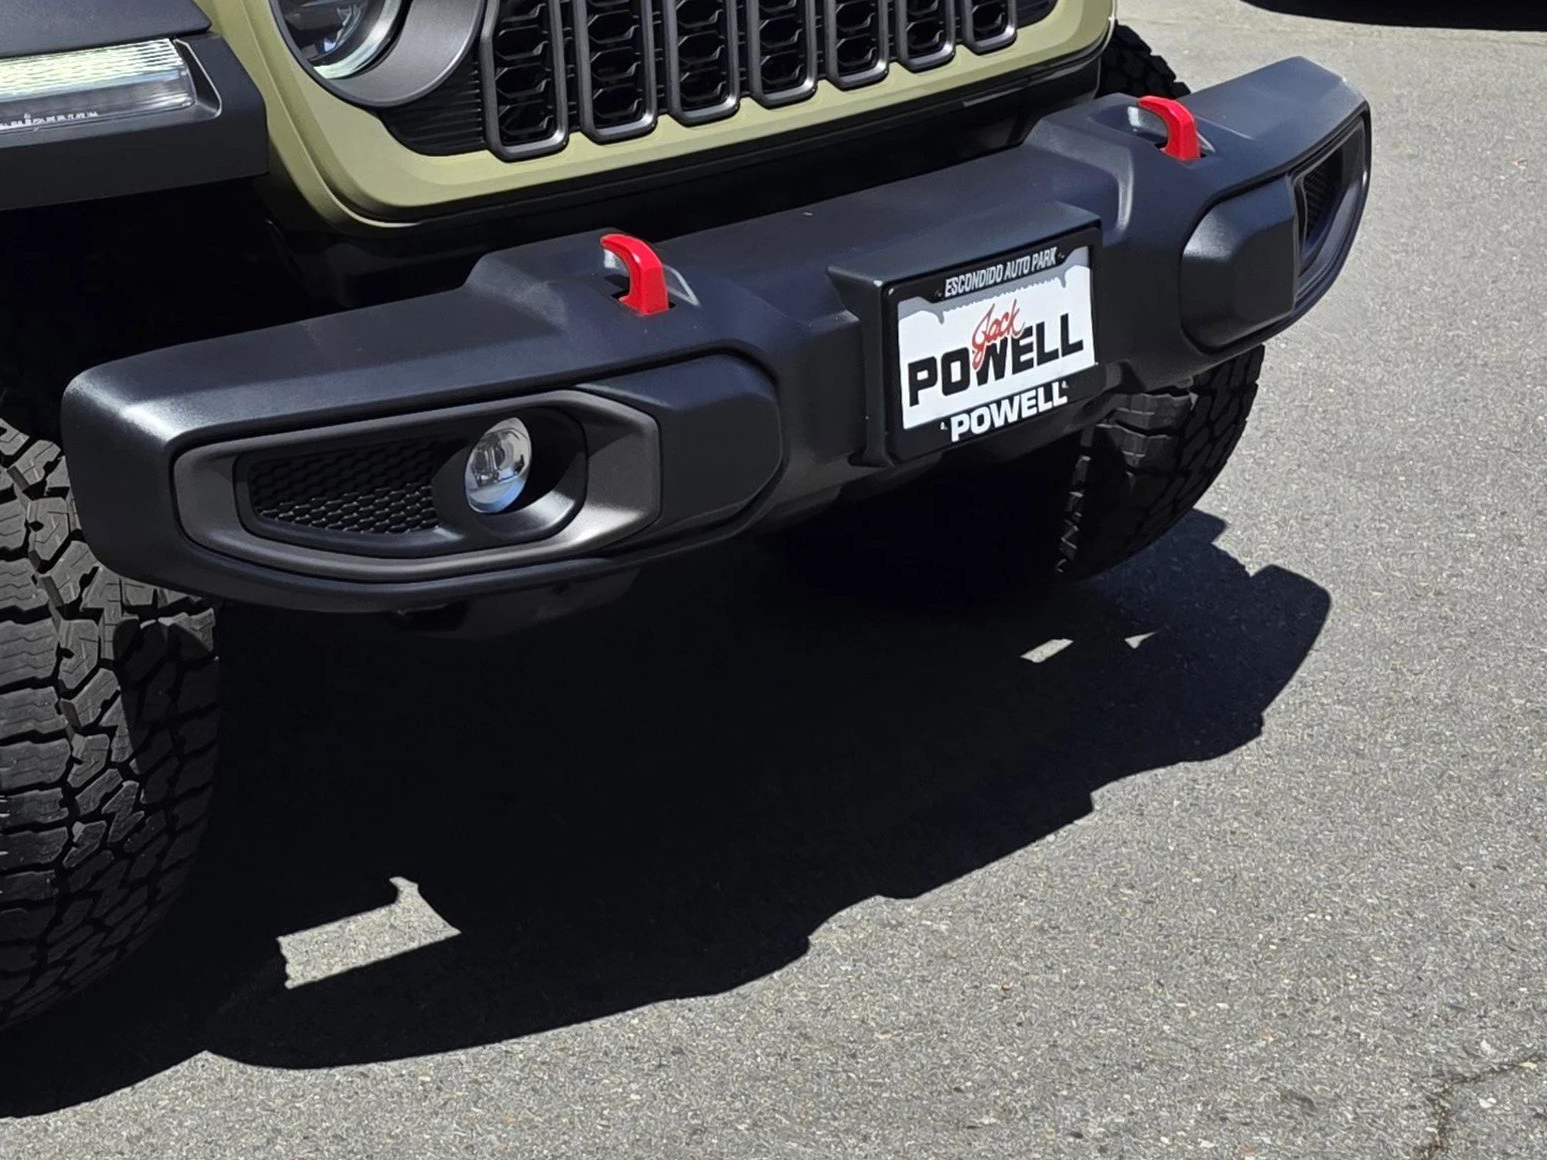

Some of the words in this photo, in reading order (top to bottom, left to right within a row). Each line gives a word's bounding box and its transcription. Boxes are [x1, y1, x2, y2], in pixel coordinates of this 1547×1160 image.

[944, 265, 1004, 297] ESCONDIDO
[1004, 255, 1031, 280] AUTO
[1031, 247, 1057, 271] PARK
[908, 313, 1084, 407] POWELL
[971, 298, 1026, 371] Jack
[950, 382, 1068, 443] POWELL
